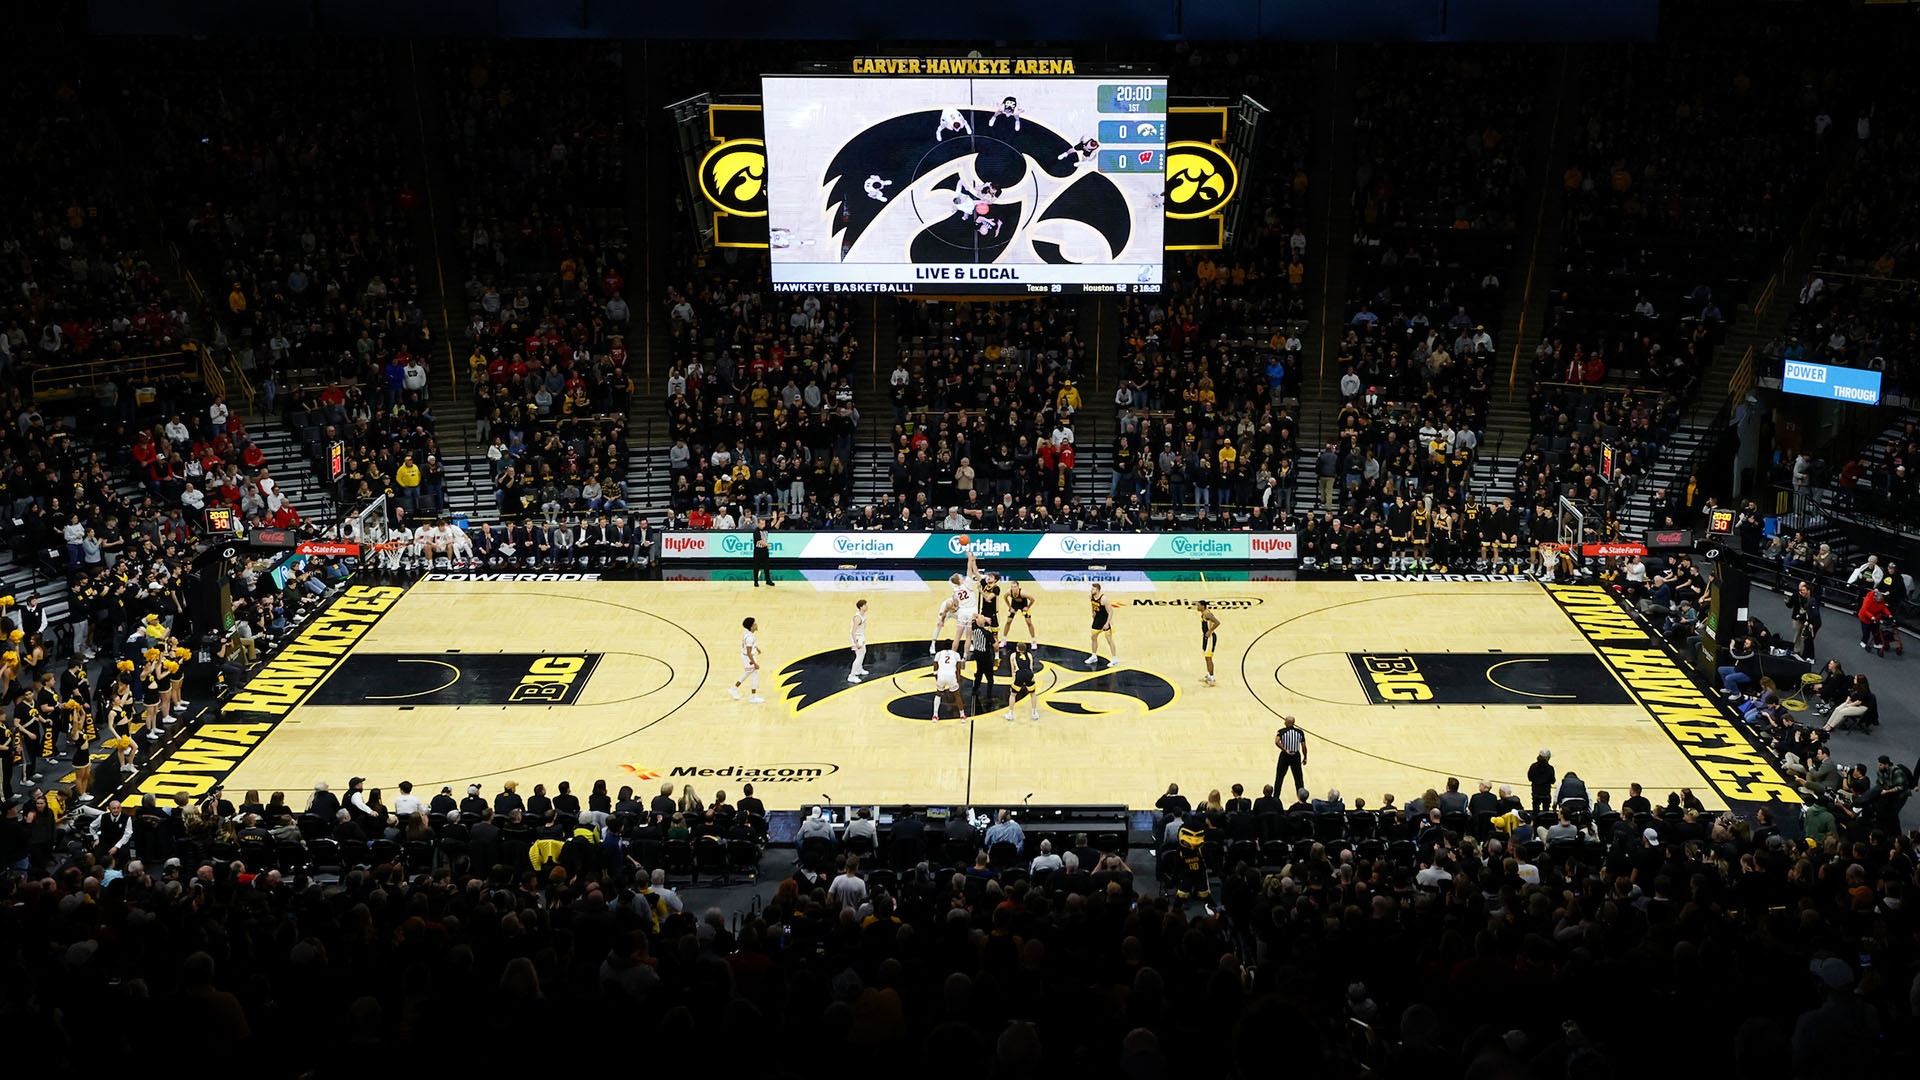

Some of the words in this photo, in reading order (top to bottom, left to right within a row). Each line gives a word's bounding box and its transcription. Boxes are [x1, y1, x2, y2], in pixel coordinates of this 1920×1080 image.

[852, 59, 1010, 74] CARVER-HAWKEYE
[1014, 59, 1075, 74] ARENA
[1116, 86, 1152, 102] 20:00
[1128, 103, 1140, 112] 1ST
[1119, 125, 1127, 139] 0
[1119, 154, 1127, 169] 0
[916, 267, 950, 280] LIVE
[954, 267, 965, 280] &
[969, 267, 1020, 280] LOCAL
[773, 283, 830, 293] HAWKEYE
[833, 283, 913, 293] BASKETBALL!
[1026, 284, 1048, 292] Texas
[1083, 283, 1114, 292] Houston
[1116, 283, 1127, 293] 52
[1786, 364, 1825, 381] POWER
[1832, 384, 1877, 402] THROUGH
[214, 519, 228, 530] 30
[1714, 520, 1728, 531] 30
[724, 536, 783, 552] Verian
[835, 537, 894, 551] Veridian
[1062, 537, 1121, 552] Veridian
[1173, 537, 1232, 552] Veridian
[421, 572, 602, 582] POWERADE
[1354, 573, 1530, 583] POWERADE
[957, 590, 970, 601] 22
[1544, 583, 1651, 641] IOWA
[221, 585, 405, 714] HAWKEYES
[944, 655, 951, 664] 2
[1599, 645, 1805, 804] HAWKEYES
[41, 727, 55, 758] IOWA
[669, 765, 823, 777] Mediacom
